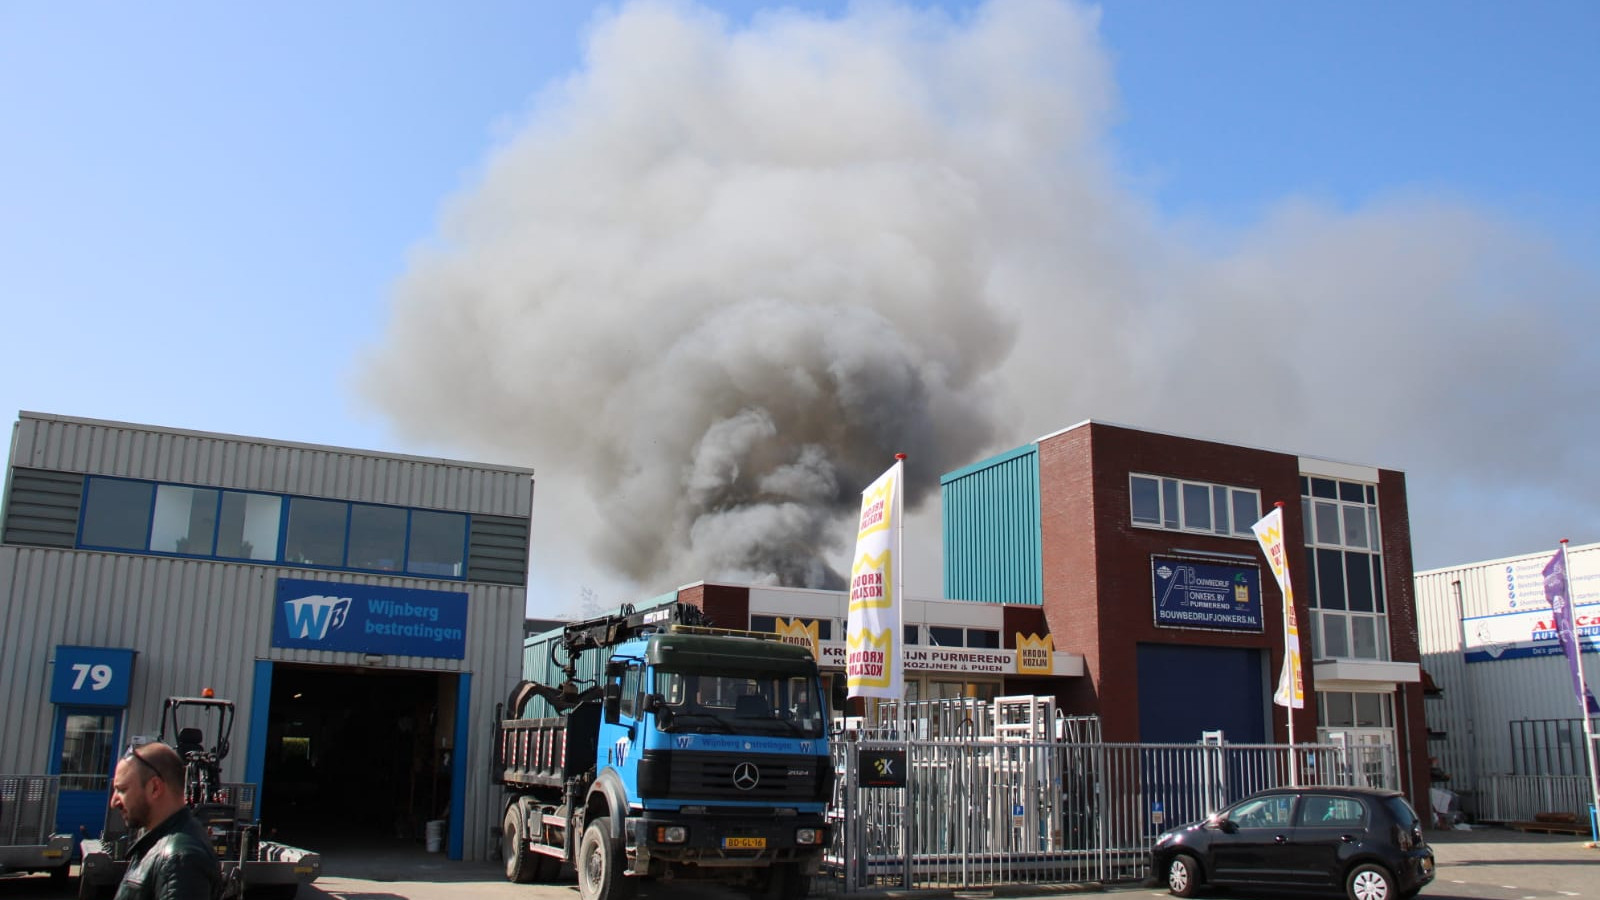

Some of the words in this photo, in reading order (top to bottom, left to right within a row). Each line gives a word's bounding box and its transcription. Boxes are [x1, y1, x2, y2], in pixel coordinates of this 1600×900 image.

[367, 599, 439, 622] Wijnberg
[1189, 602, 1231, 610] PURMEREND
[1160, 610, 1258, 625] BOUWBEDRIJFJONKERS.NL
[365, 619, 462, 641] bestratingen
[932, 652, 1011, 665] PURMEREND
[1022, 649, 1048, 658] KROON
[904, 661, 958, 671] KOZIJNEN
[1022, 658, 1048, 668] KOZIJN
[72, 664, 113, 691] 79
[702, 738, 740, 748] Wijnberg
[742, 739, 792, 750] bstratingen
